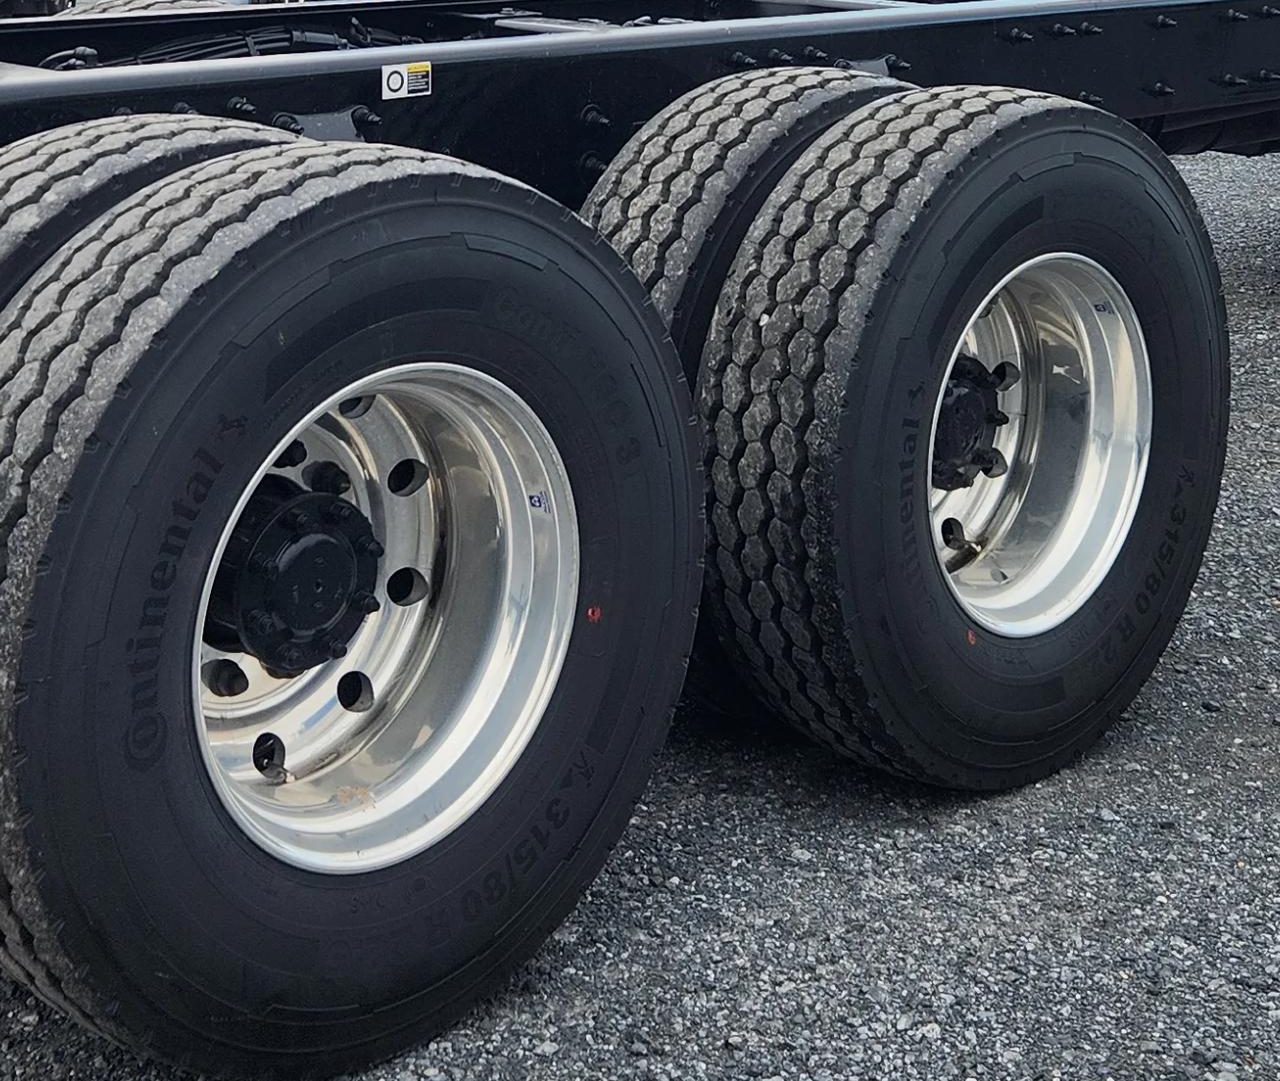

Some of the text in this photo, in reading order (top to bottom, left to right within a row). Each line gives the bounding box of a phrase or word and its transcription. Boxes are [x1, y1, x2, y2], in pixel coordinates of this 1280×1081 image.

[124, 447, 224, 767] Continental
[1135, 503, 1187, 615] 315/80
[460, 797, 571, 923] 315/80
